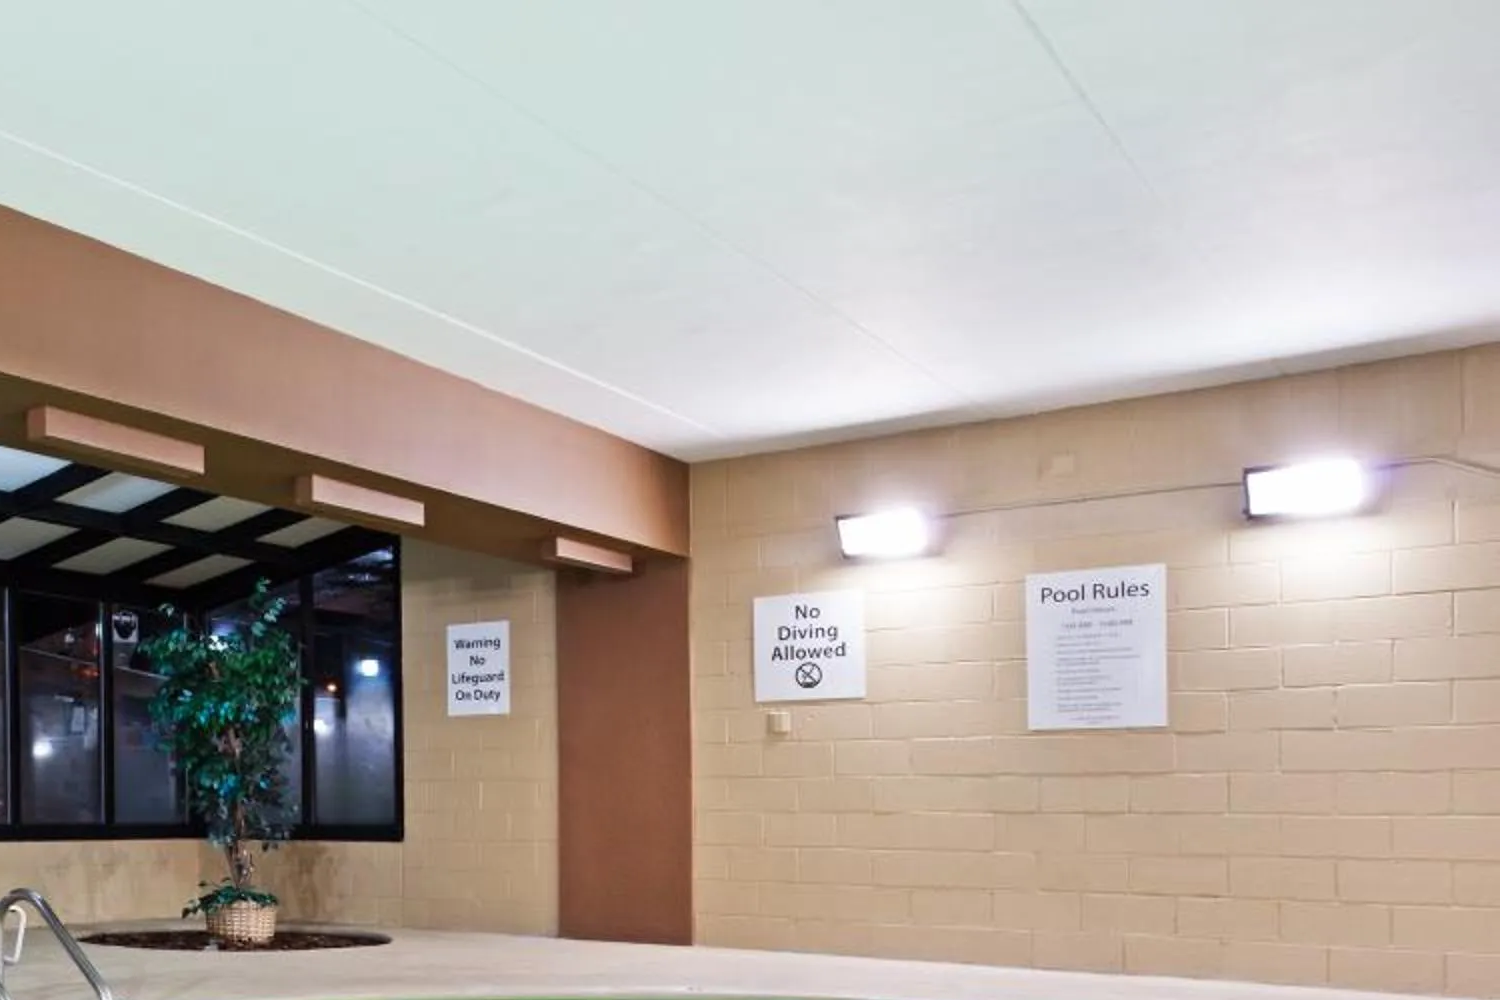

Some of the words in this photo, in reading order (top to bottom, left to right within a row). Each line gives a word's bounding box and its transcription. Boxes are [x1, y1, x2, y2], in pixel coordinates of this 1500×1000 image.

[1041, 584, 1085, 604] Pool
[1093, 581, 1150, 600] Rules
[795, 604, 821, 620] No
[777, 624, 838, 641] Diving
[453, 637, 501, 651] Warning
[771, 642, 847, 661] Allowed
[469, 655, 485, 666] No
[451, 670, 505, 687] Lifeguard
[455, 690, 472, 702] On
[473, 689, 501, 702] Duty
